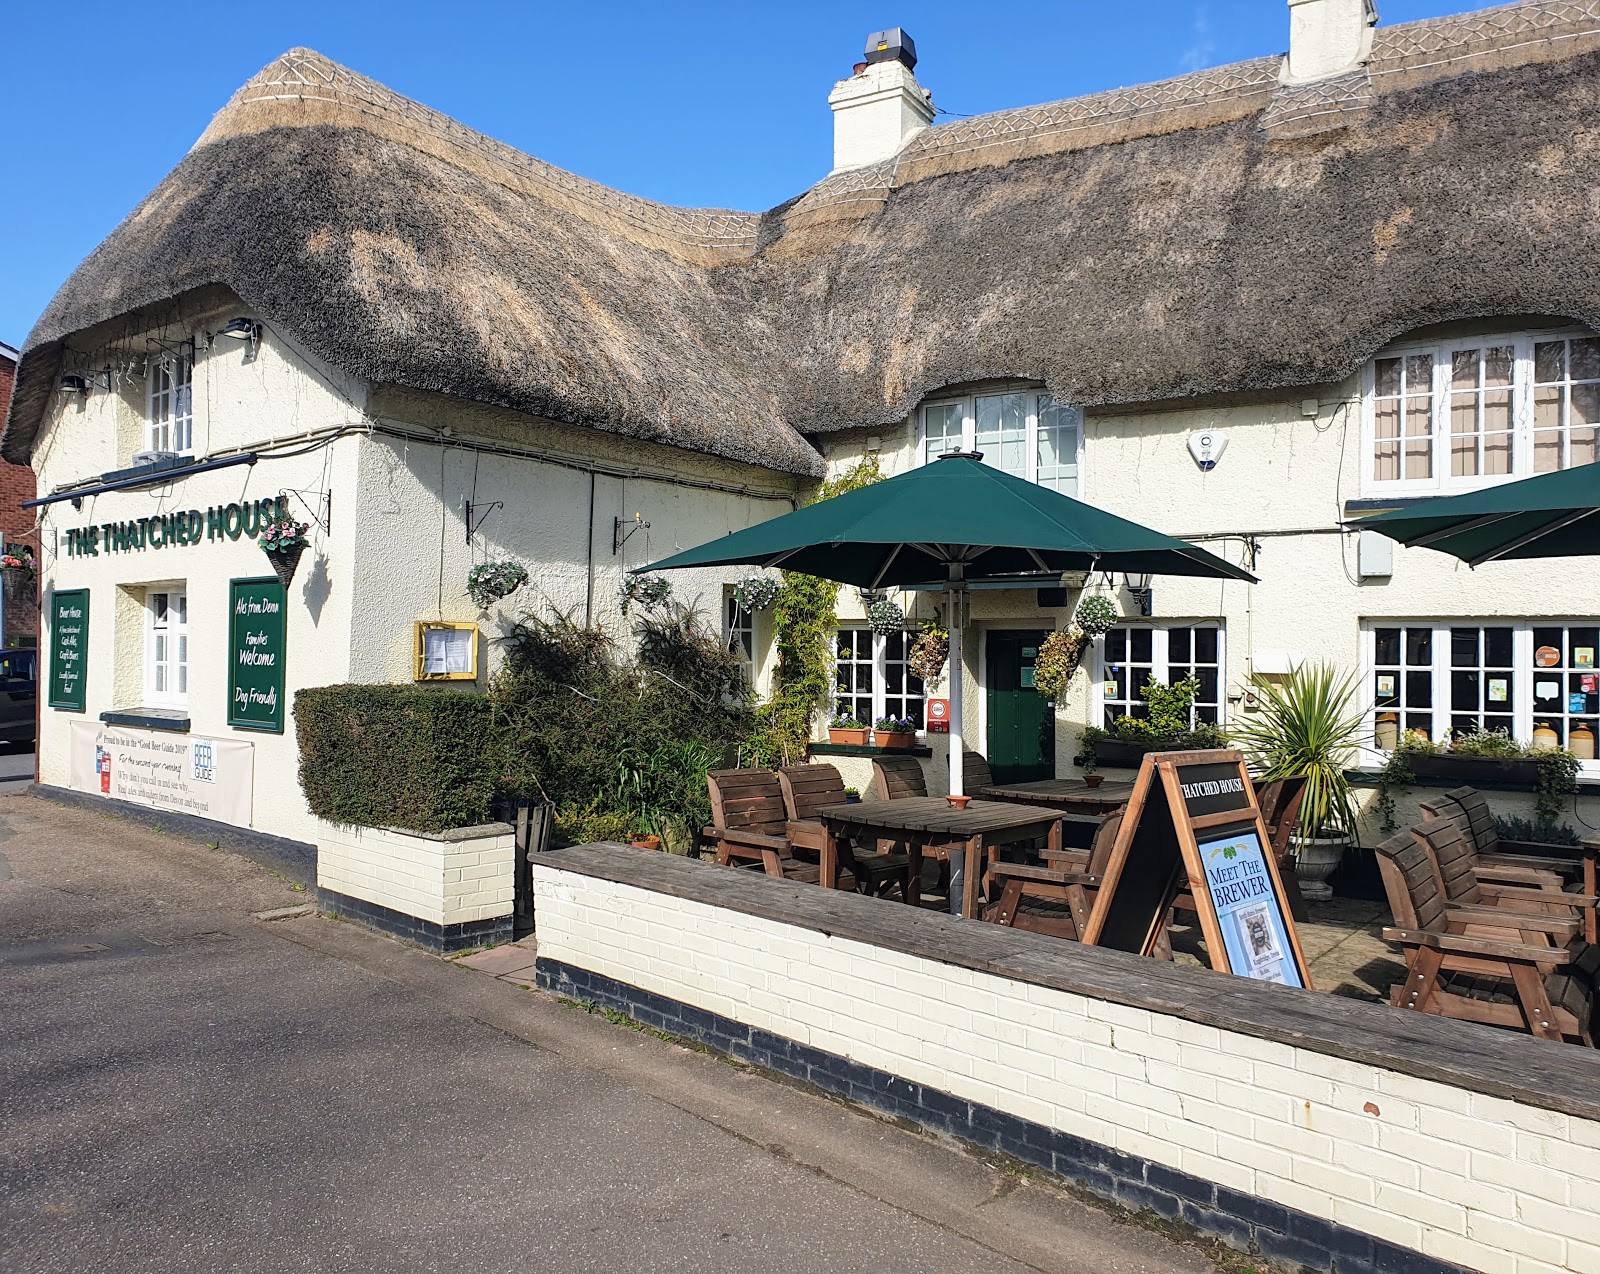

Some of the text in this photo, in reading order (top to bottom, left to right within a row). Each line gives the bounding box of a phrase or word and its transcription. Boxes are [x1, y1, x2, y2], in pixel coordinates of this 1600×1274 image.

[66, 525, 98, 557] THE
[101, 510, 203, 555] THATCHED
[59, 606, 69, 618] Beer
[235, 596, 279, 616] Ales from Devon
[246, 630, 268, 646] Families
[239, 645, 275, 667] Welcome
[235, 685, 277, 715] Dog Friendly
[103, 734, 115, 745] Proud
[120, 736, 126, 747] be
[152, 740, 161, 751] Beer
[161, 741, 174, 753] Guide
[119, 753, 128, 764] For
[135, 758, 151, 768] second
[194, 743, 212, 769] BEER
[117, 770, 129, 783] Why
[140, 776, 149, 786] you
[149, 776, 157, 786] call
[162, 779, 170, 789] and
[194, 767, 212, 781] GUIDE
[1218, 778, 1245, 794] HOUSE
[117, 783, 127, 795] Real
[159, 791, 170, 803] from
[170, 793, 183, 806] Devon
[184, 797, 193, 808] and
[192, 798, 209, 812] beyond
[1208, 860, 1262, 886] MEET THE
[1213, 875, 1269, 908] BREWER
